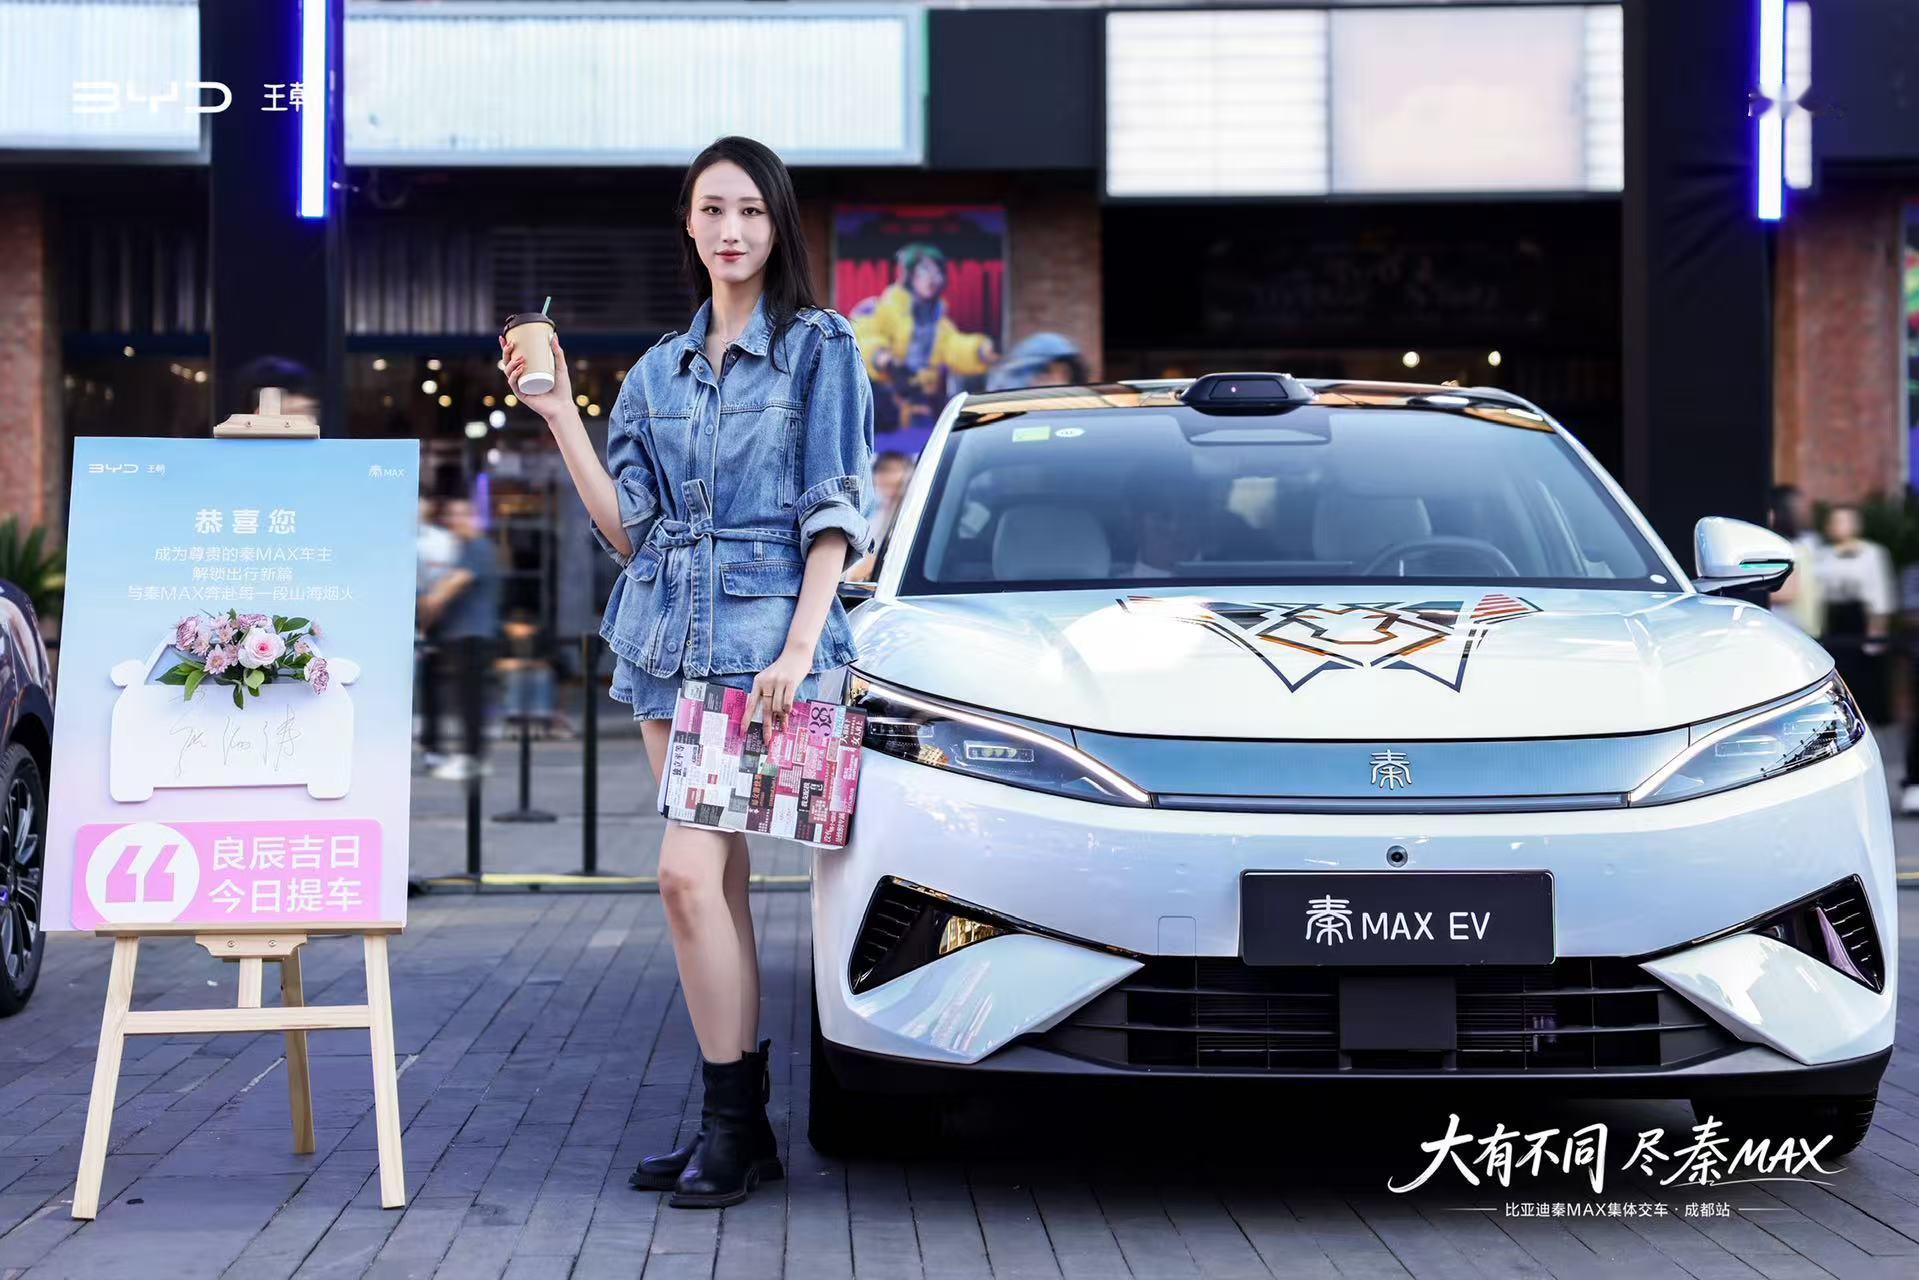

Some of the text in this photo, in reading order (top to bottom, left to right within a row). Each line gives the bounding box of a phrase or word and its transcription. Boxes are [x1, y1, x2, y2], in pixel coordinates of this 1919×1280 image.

[88, 463, 139, 474] BYD
[195, 509, 297, 534] 恭喜您
[154, 546, 333, 562] 成为尊贵的秦MAX车主
[192, 566, 293, 582] 解锁出行新篇
[128, 585, 353, 601] 与秦MAX奔赴每一段山海烟火
[1369, 749, 1412, 789] 秦
[212, 834, 361, 871] 良辰吉日
[208, 877, 363, 914] 今日提车
[1450, 912, 1490, 940] EV
